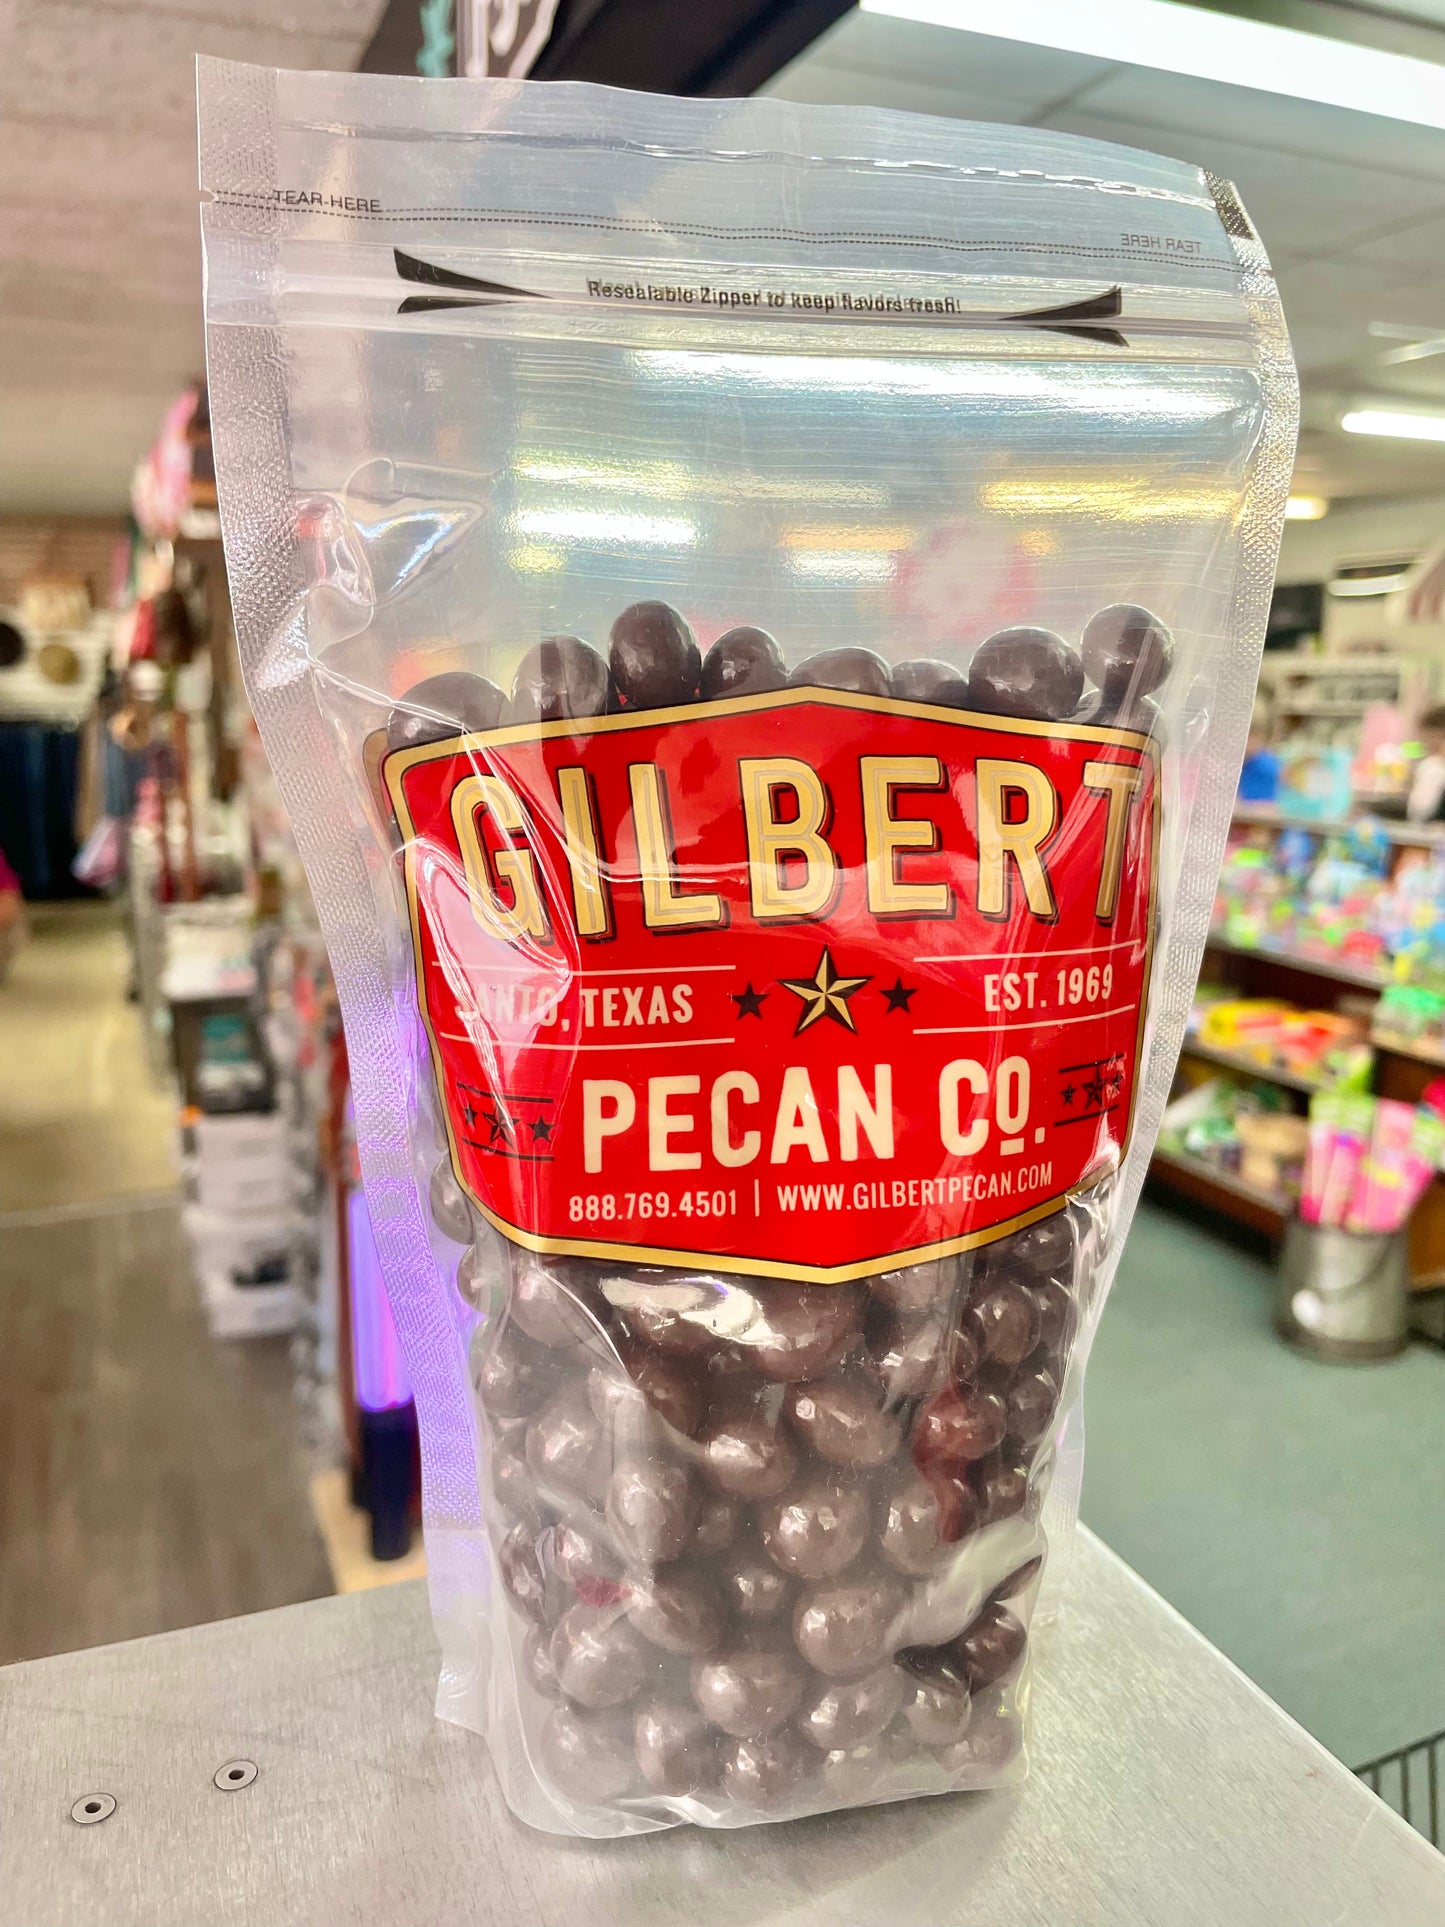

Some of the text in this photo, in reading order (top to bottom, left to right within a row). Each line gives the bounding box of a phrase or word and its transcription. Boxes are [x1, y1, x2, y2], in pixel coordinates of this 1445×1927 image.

[273, 189, 382, 213] TEAR HERE
[587, 280, 694, 304] Resealable
[701, 286, 761, 309] Zipper
[766, 290, 786, 308] to
[792, 292, 835, 313] keep
[842, 292, 903, 313] flavors
[450, 756, 1143, 942] GILBERT
[580, 984, 693, 1027] TEXAS
[984, 963, 1113, 1012] EST. 1969
[582, 1063, 895, 1174] PECAN
[569, 1161, 1052, 1222] 888.769.4501 WWW.GILBERTPECAN.COM
